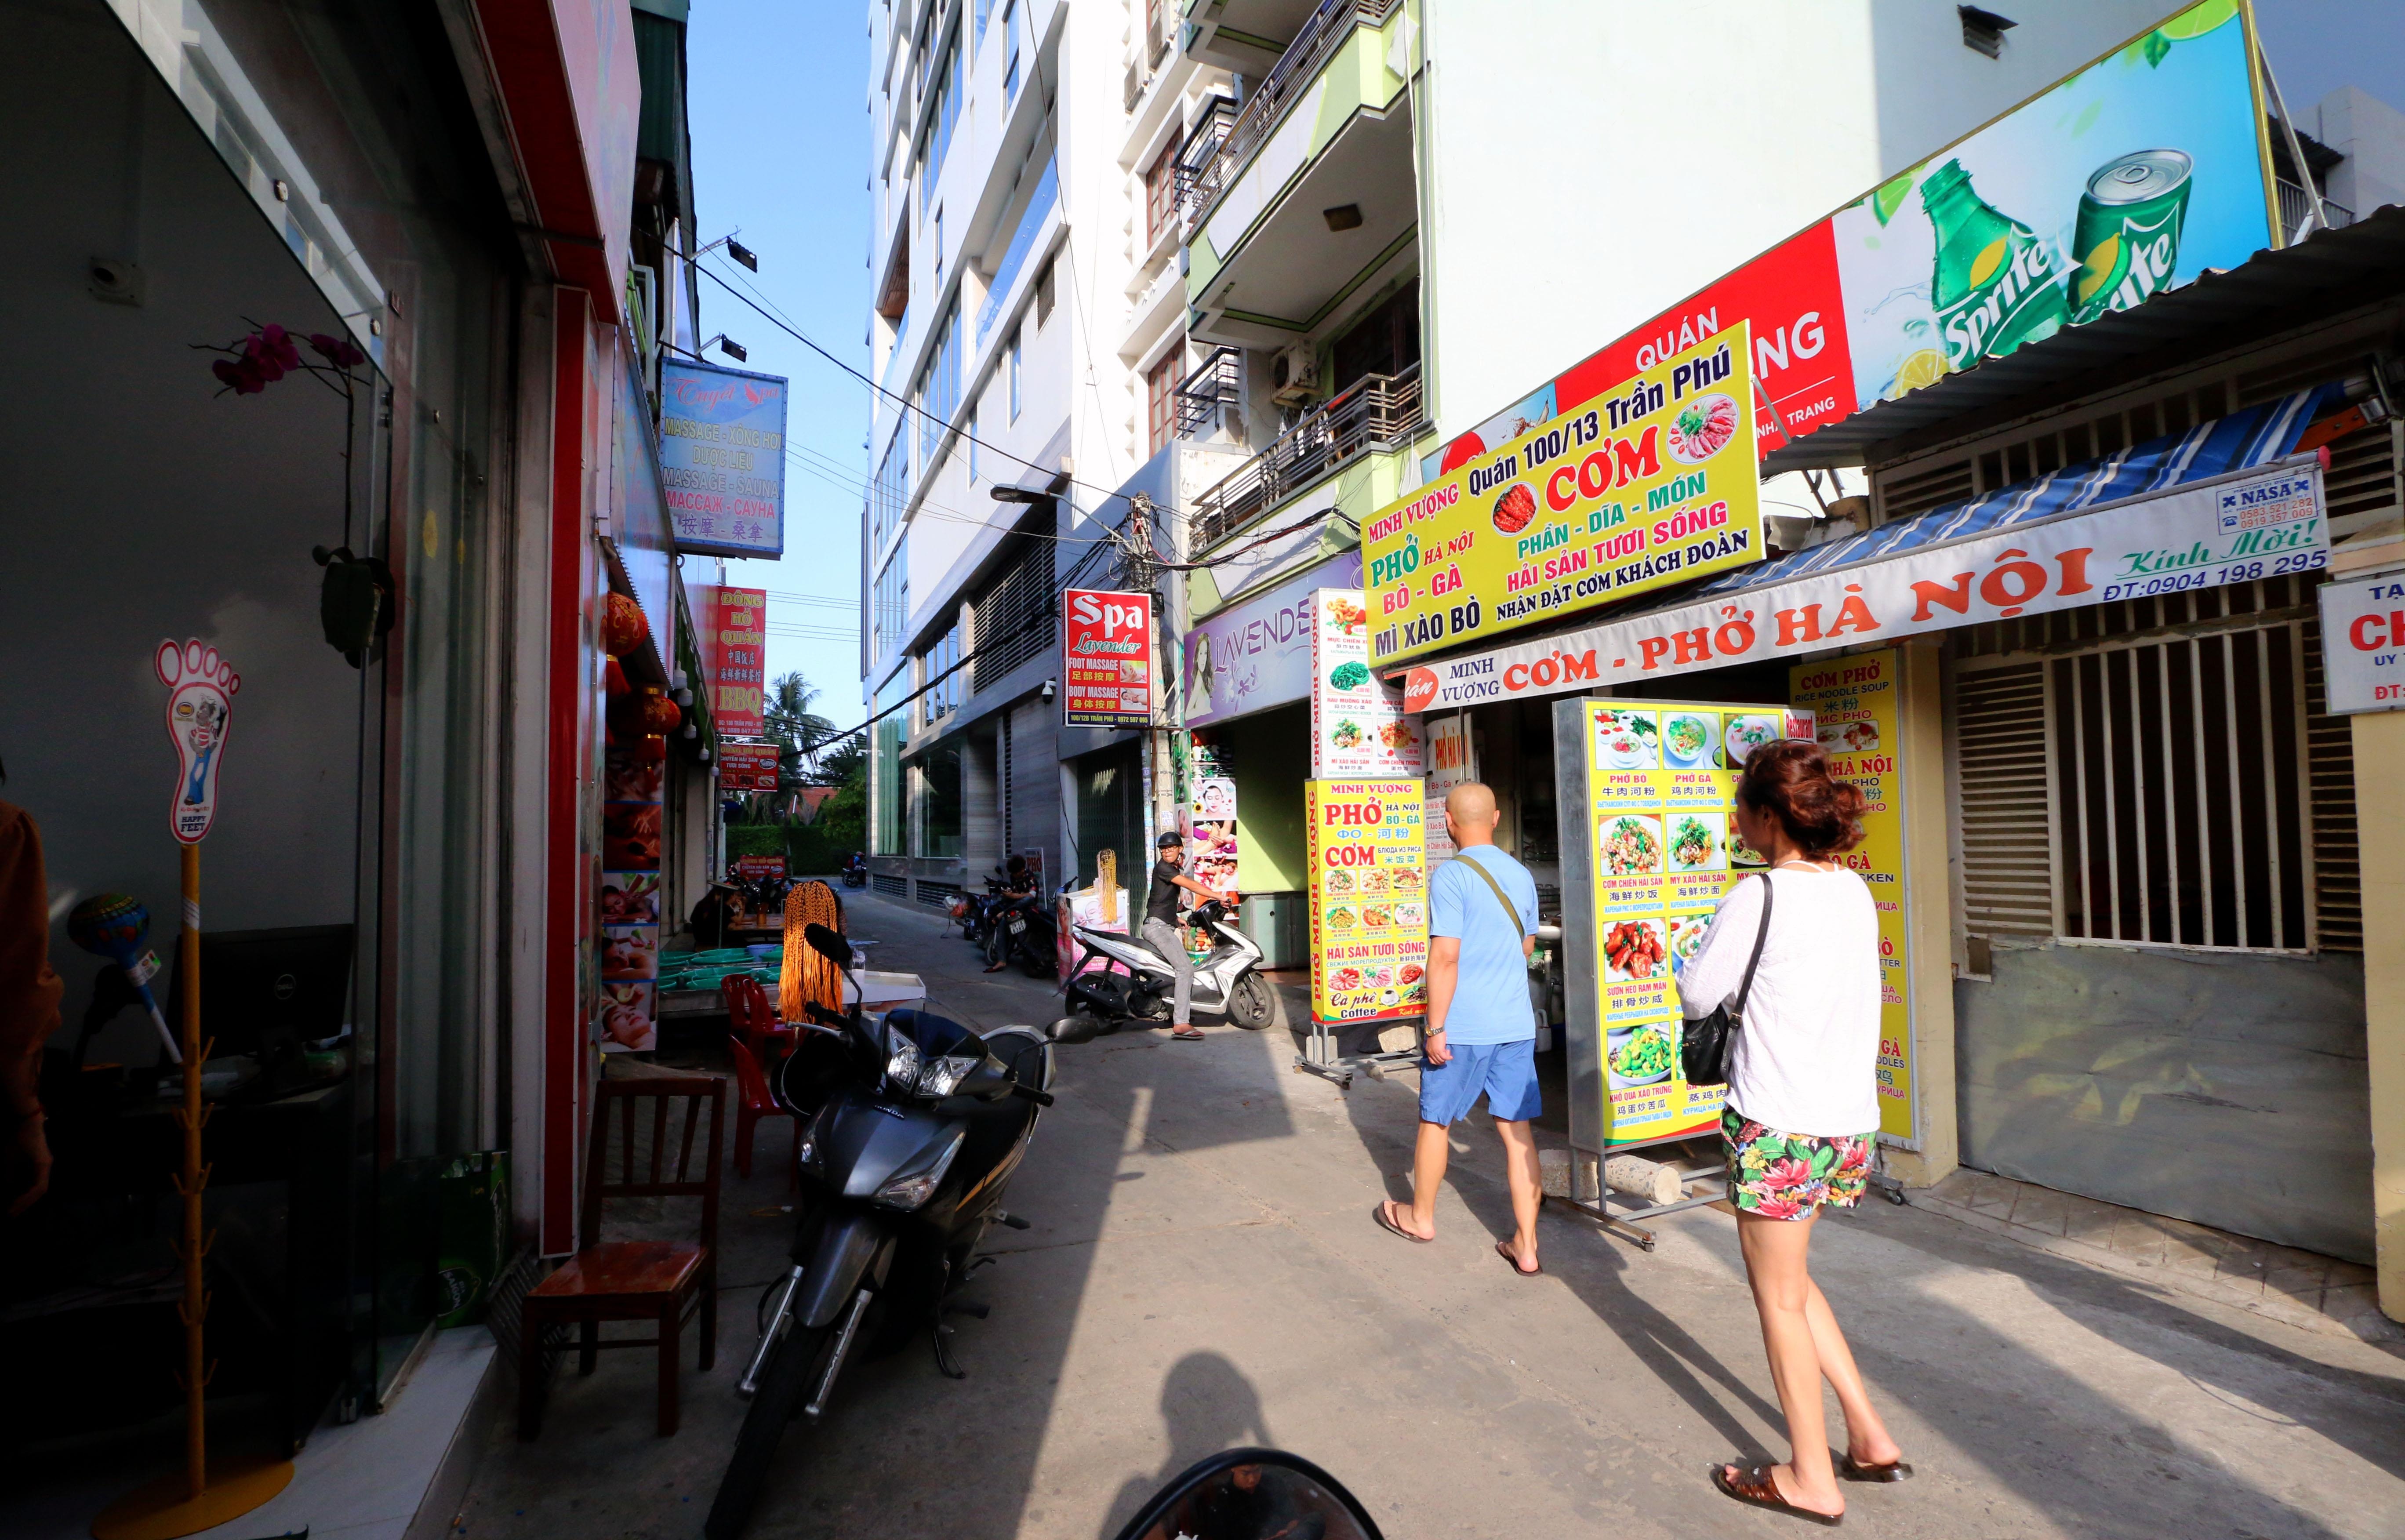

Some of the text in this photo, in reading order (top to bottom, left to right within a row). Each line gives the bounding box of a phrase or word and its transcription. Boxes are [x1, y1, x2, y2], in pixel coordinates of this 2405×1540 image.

[1945, 240, 2051, 372] Sprite
[1636, 306, 1719, 372] QUÁN
[744, 378, 779, 407] Spa
[1469, 459, 1517, 497] Quán
[1523, 411, 1599, 469] 100/13
[1606, 380, 1665, 431] Trần
[1672, 342, 1731, 399] Phú
[1787, 397, 1835, 425] TRANG
[665, 418, 781, 450] MASSAGE XÔNG HƠI
[693, 446, 754, 473] DƯỢC LIỆU
[1546, 426, 1661, 512] CƠM
[663, 468, 780, 499] MASSAGE SAUNA
[667, 491, 775, 519] МАССАЖ САУНА
[2242, 484, 2291, 505] NASA
[1369, 483, 1459, 544] MINH VƯỢNG
[1518, 472, 1705, 558] PHẦN DĨA MÓN
[2241, 498, 2313, 519] 0583.521.282
[2242, 508, 2313, 528] 0919.357.009
[681, 513, 763, 542] 按摩 桑拿
[1507, 501, 1727, 593] HẢI SẢN TƯƠI SỐNG
[2116, 519, 2318, 578] Kính Mời!
[1371, 531, 1474, 588] PHỞ HÀ NỘI
[1497, 530, 1748, 621] NHẬN ĐẶT CƠM KHÁCH ĐOÀN
[2103, 550, 2326, 602] ĐT:0904 198 295
[722, 590, 763, 608] ĐÔNG
[1382, 563, 1463, 614] BÒ GÀ
[1071, 594, 1143, 639] Spa
[1503, 547, 2095, 691] CƠM PHỞ HÀ NỘI
[721, 628, 763, 645] QUÁN
[1375, 597, 1481, 658] MÌ XÀO BÒ
[1072, 632, 1141, 655] Lavender
[727, 649, 755, 665] 中国饭店
[1069, 657, 1118, 671] FOOT MASSAGE
[2375, 654, 2396, 665] UY
[1072, 672, 1115, 682] 足部按摩
[1449, 658, 1494, 680] MINH
[1802, 660, 1881, 690] CƠM PHỞ
[719, 686, 762, 718] BBQ
[1069, 686, 1118, 698] BODY MASSAGE
[1442, 680, 1499, 703] VƯỢNG
[1795, 682, 1889, 703] RICE NOODLE SOUP
[1073, 699, 1116, 709] 身体按摩
[1823, 697, 1859, 713] 米粉
[1786, 714, 1813, 739] Restaurant
[1833, 754, 1893, 777] HÀ NỘI
[1610, 773, 1646, 783] PHỞ BÒ
[1675, 773, 1711, 782] PHỞ GÀ
[1331, 785, 1412, 795] MINH VƯỢNG
[1602, 787, 1655, 796] 牛肉河粉
[1671, 786, 1716, 795] 鸡肉河粉
[1324, 797, 1381, 825] PHỞ
[1402, 803, 1420, 812] NỘI
[1386, 814, 1399, 824] BÒ
[1407, 814, 1420, 824] GÀ
[181, 823, 205, 832] FEET
[1309, 790, 1318, 875] VƯỢNG
[1378, 828, 1409, 839] 河粉
[1325, 843, 1375, 867] CƠM
[1847, 851, 1871, 870] GÀ
[1603, 875, 1663, 888] CƠM CHIÊN HẢI SẢN
[1670, 872, 1726, 884] MỲ XÀO HẢI SẢN
[1609, 890, 1658, 901] 海鲜炒饭
[1678, 886, 1720, 897] 海鲜炒面
[1327, 940, 1424, 959] HẢI SẢN TƯƠI SỐNG
[1351, 957, 1395, 966] МОРЕПРОДУКТЫ
[1311, 953, 1321, 1001] PHỞ
[1331, 991, 1377, 1008] Cà phê
[1607, 984, 1651, 996] SƯỜN HEO RAM
[1612, 994, 1662, 1009] 排骨炒咸
[1341, 1008, 1377, 1018] Coffee
[1881, 1037, 1901, 1057] GÀ
[1609, 1090, 1622, 1103] KHỔ
[1638, 1089, 1650, 1097] XÀO
[1653, 1085, 1672, 1095] TRỨNG
[1617, 1099, 1666, 1115] 鸡蛋炒苦瓜
[1683, 1105, 1706, 1115] КУРИЦА
